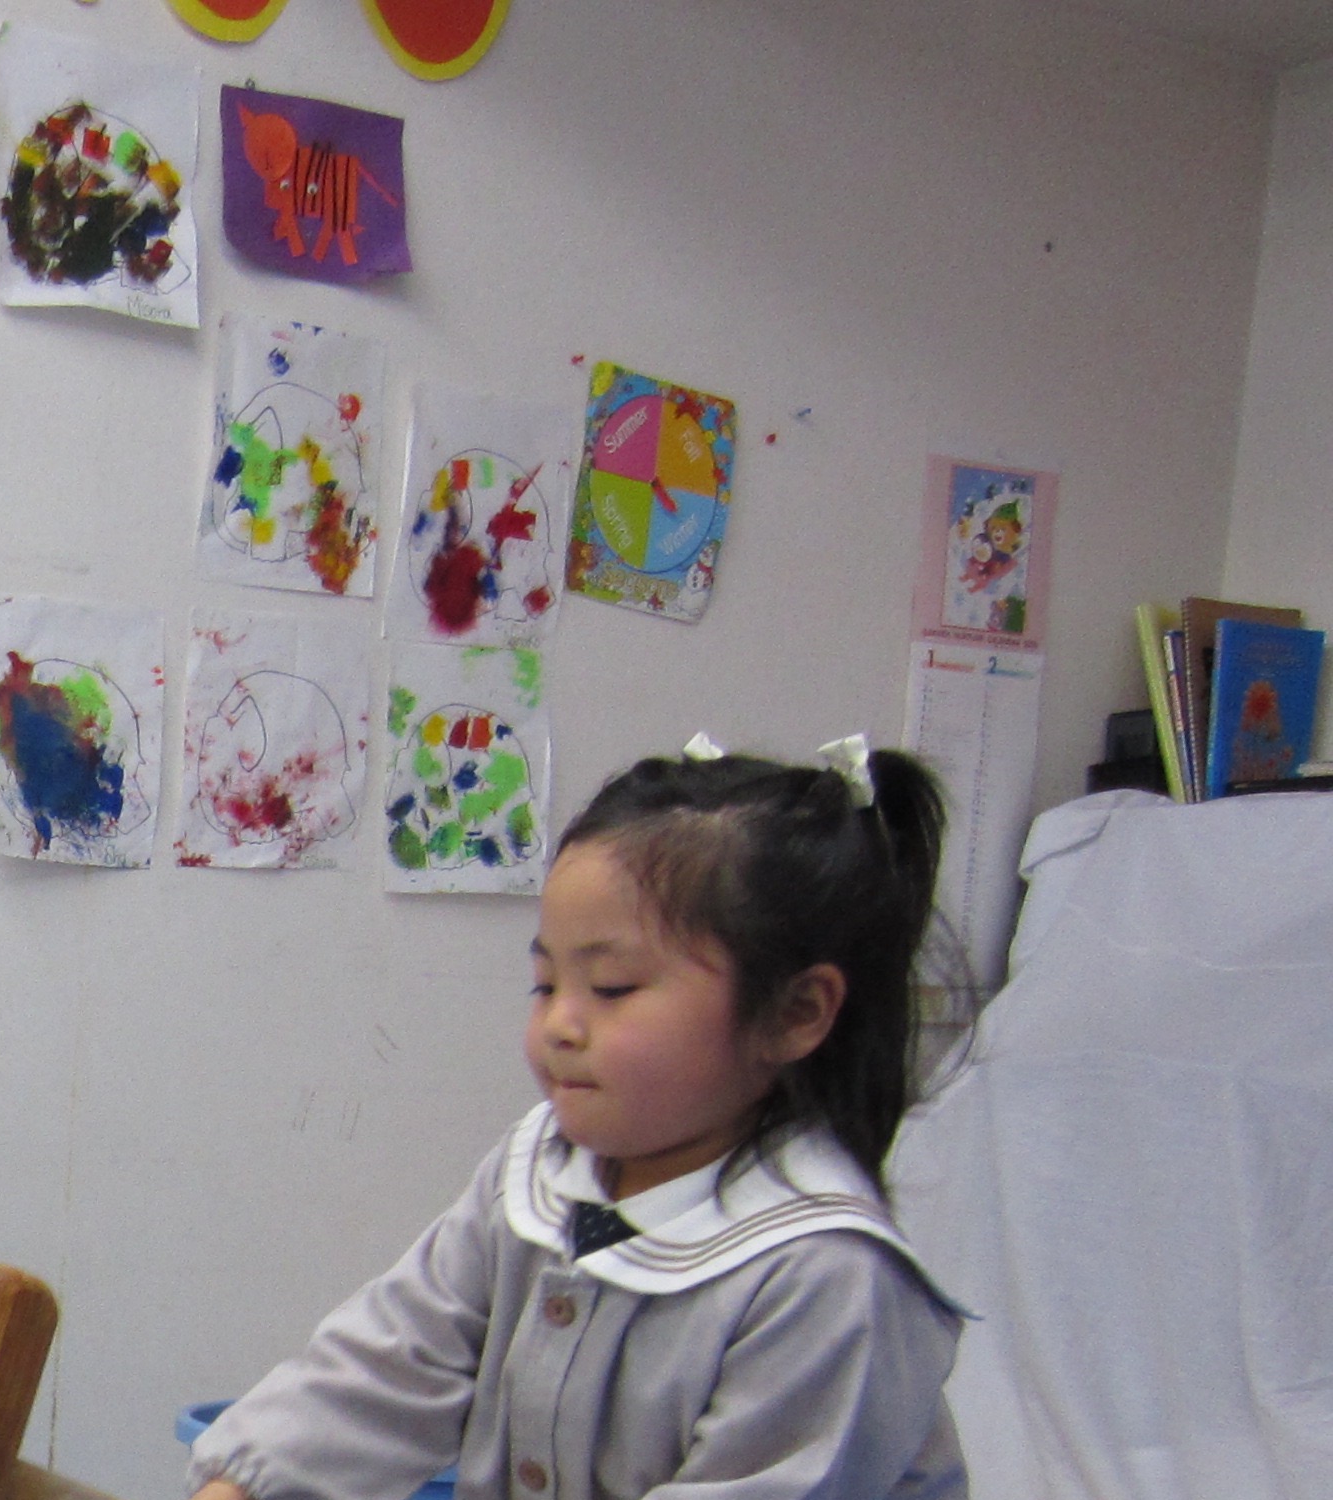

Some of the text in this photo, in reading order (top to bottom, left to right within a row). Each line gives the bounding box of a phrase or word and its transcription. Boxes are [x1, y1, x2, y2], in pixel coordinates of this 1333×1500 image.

[603, 404, 649, 454] Summer
[681, 431, 706, 464] Fall
[602, 492, 633, 550] Spring
[656, 514, 700, 556] Winter
[988, 655, 997, 674] 2
